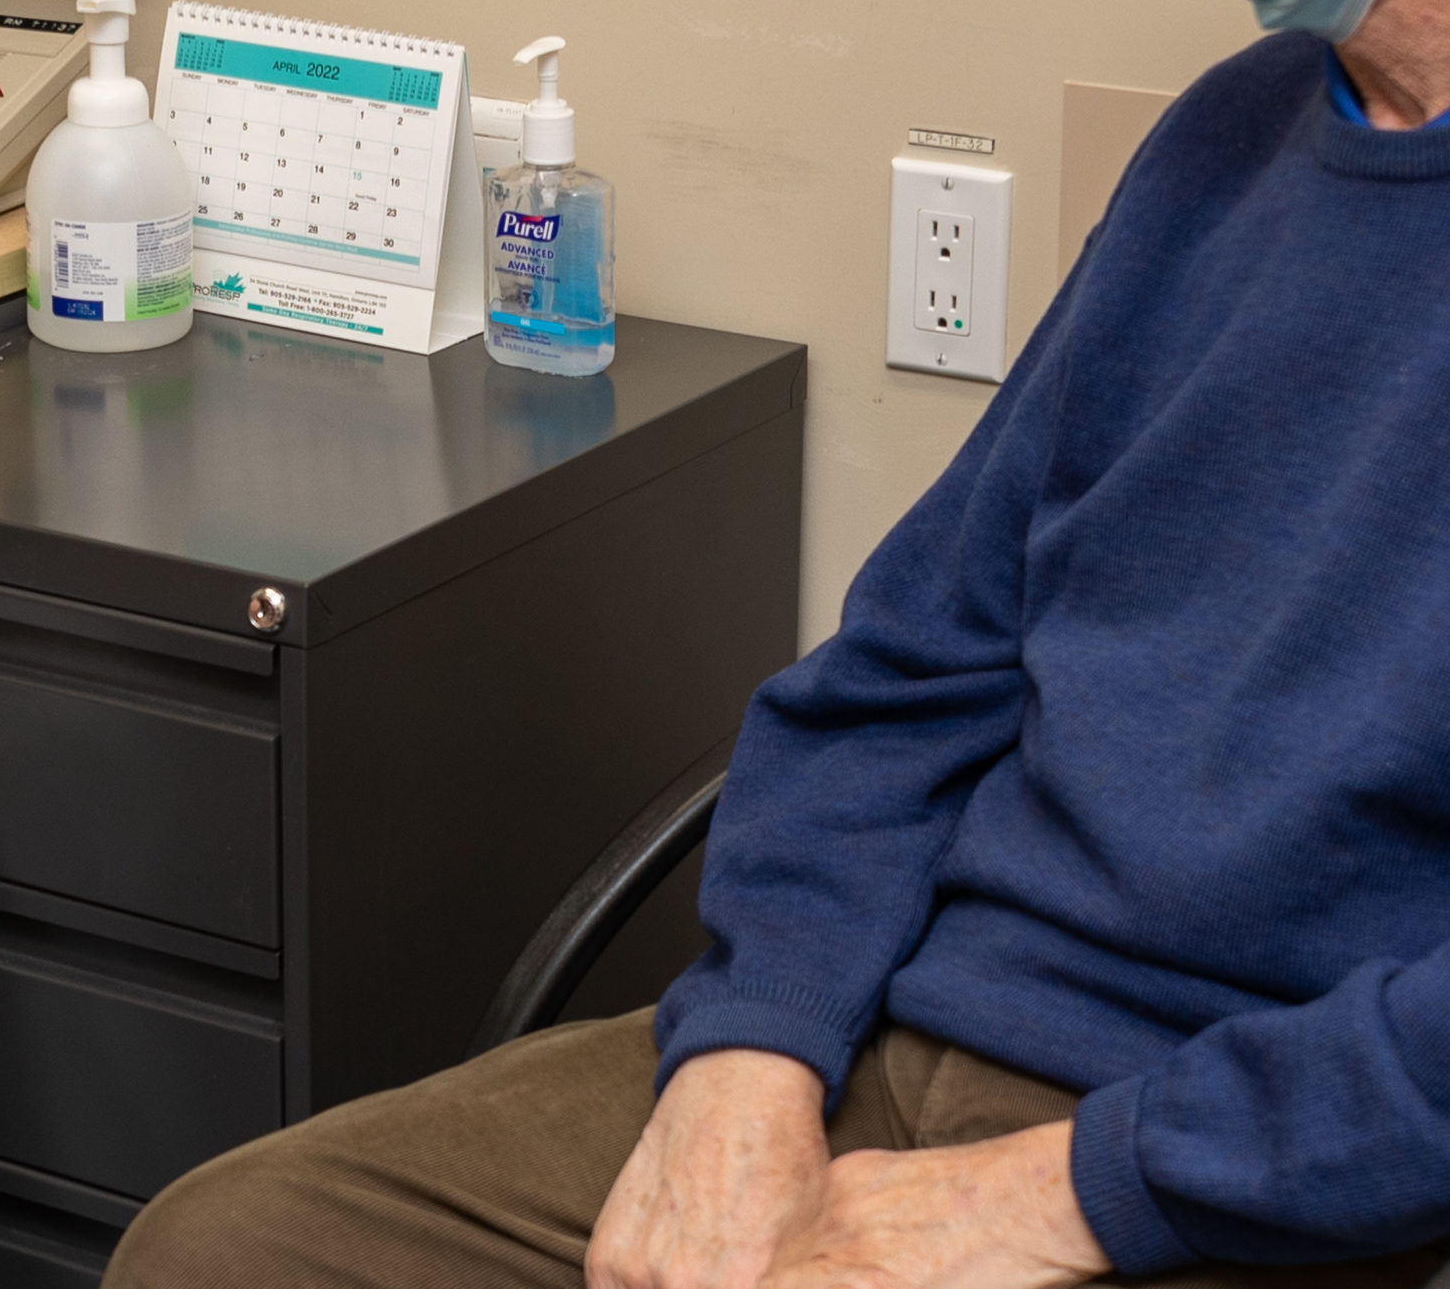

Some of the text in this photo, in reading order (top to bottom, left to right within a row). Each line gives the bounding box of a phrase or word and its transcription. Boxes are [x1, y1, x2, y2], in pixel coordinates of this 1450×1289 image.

[272, 61, 341, 81] APRIL 2022
[182, 73, 430, 117] SUNDAY MONDAY TUESDAY WEDNESDAY THURSDAY FRIDAY SATURDAY
[360, 111, 403, 125] 1 2
[170, 111, 399, 156] 3 4 5 6 7 8 9
[203, 146, 400, 187] 11 12 13 14 15 16
[201, 176, 397, 217] 18 19 20 21 22 23
[198, 205, 395, 248] 25 26 27 28 29 30
[503, 213, 554, 240] Purell
[501, 242, 554, 260] ADVANCED
[508, 260, 546, 276] AVANCÉ
[259, 288, 269, 296] Tel:
[319, 299, 332, 308] Fax:
[333, 301, 376, 316] 905-529-2224
[278, 299, 355, 320] Toll Free: 1-800-265-3727
